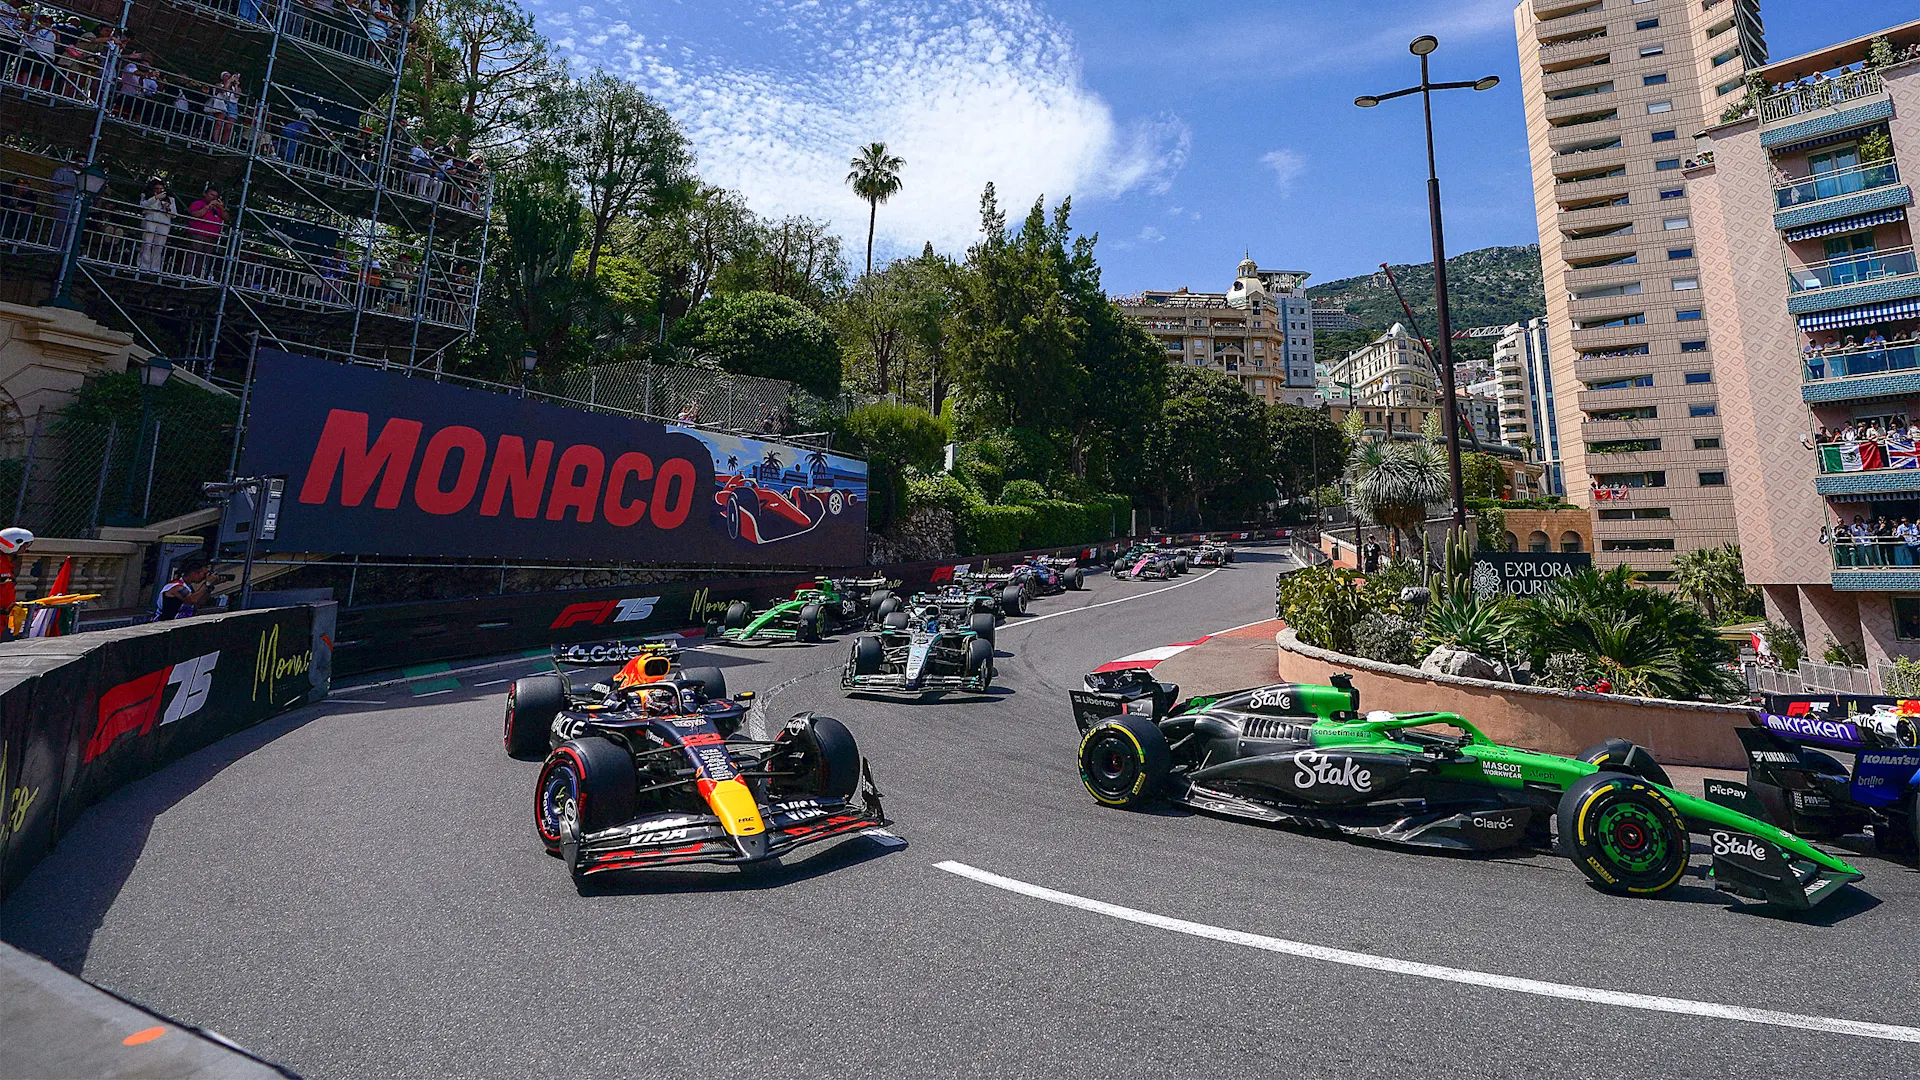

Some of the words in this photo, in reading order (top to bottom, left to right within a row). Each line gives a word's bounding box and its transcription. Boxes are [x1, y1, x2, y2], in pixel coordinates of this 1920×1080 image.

[299, 409, 697, 530] MONACO
[1504, 561, 1574, 577] EXPLORA
[549, 600, 620, 630] F1
[613, 596, 661, 622] 75
[84, 666, 174, 765] F1
[159, 650, 221, 727] 75
[1083, 696, 1116, 708] Libertex
[1250, 689, 1291, 710] Stake
[1783, 717, 1853, 741] kraken
[1482, 761, 1522, 773] MASCOT
[1862, 754, 1920, 766] KOMATSU
[1294, 751, 1372, 793] Stake
[1482, 769, 1523, 780] WORKWEAR
[1709, 784, 1747, 800] PicPay
[1647, 789, 1685, 831] ZERO
[1473, 816, 1508, 830] Claro
[629, 828, 688, 845] VISA
[1712, 832, 1767, 861] Stake
